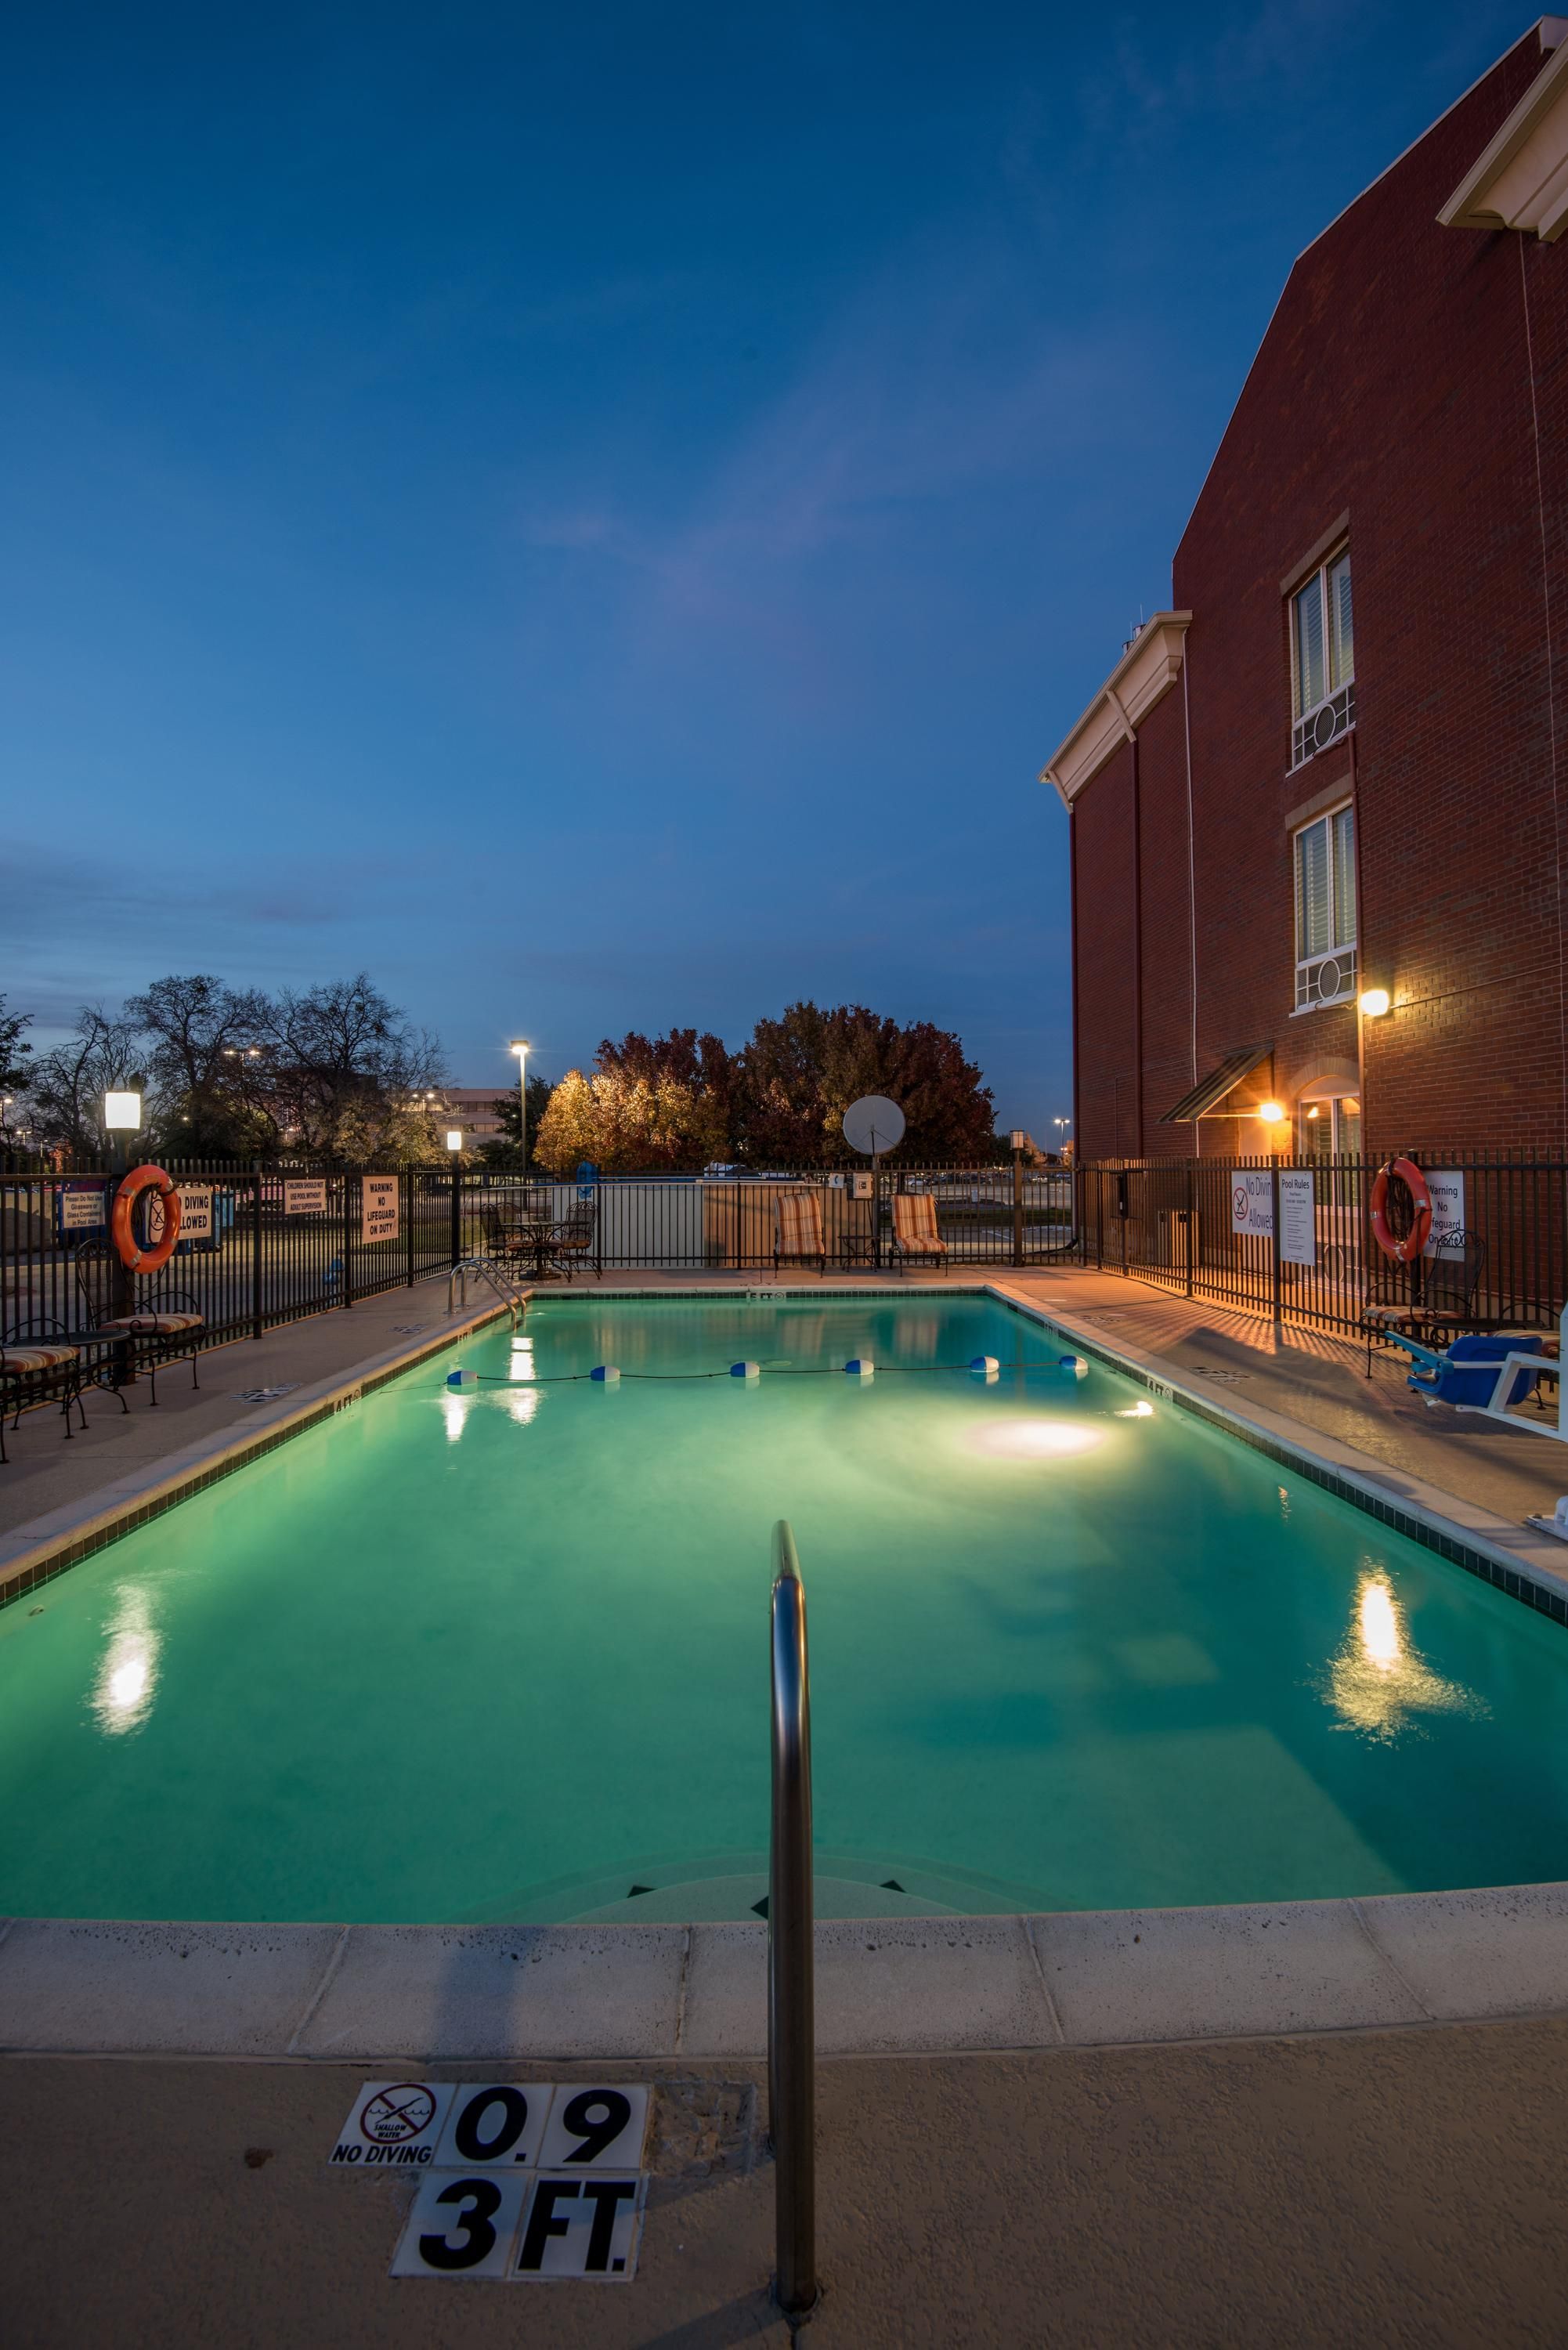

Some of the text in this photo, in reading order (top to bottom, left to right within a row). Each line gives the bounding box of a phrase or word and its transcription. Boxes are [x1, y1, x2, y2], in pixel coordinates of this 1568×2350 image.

[370, 1182, 393, 1193] WARNING
[1245, 1177, 1272, 1197] No Divin
[1281, 1178, 1310, 1190] Pool Rules
[185, 1195, 209, 1210] DIVING
[301, 1202, 322, 1210] SUPERVISION
[378, 1196, 385, 1207] NO
[1437, 1201, 1448, 1213] No
[367, 1209, 396, 1222] LIFEGUARD
[370, 1222, 393, 1235] ON DUTY
[1432, 1217, 1461, 1231] feguard
[1428, 1234, 1439, 1244] On
[374, 2124, 407, 2132] SHALLOW
[331, 2145, 432, 2164] NO DIVING
[419, 2178, 502, 2271] 3
